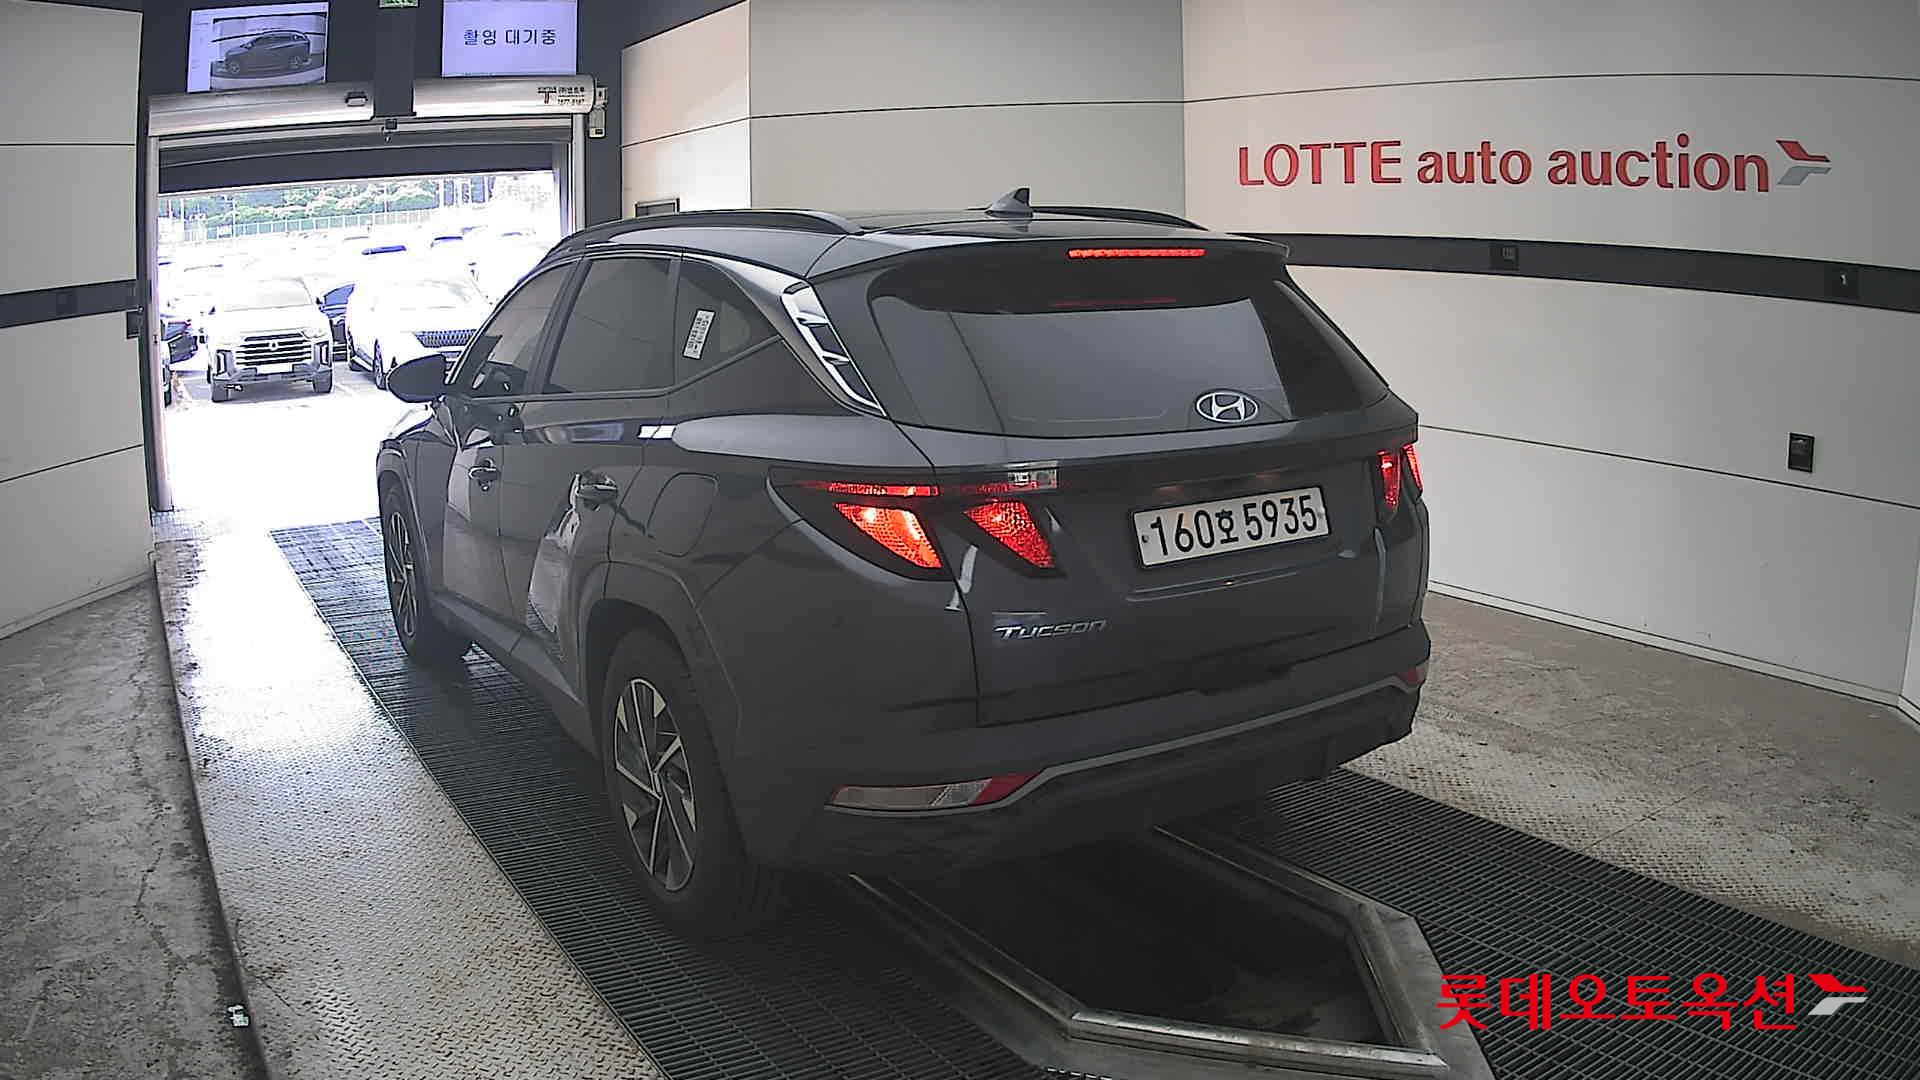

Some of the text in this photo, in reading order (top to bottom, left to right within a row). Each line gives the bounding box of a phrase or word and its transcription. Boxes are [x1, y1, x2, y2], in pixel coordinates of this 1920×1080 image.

[464, 29, 556, 45] 촬영 대기중
[1238, 133, 1769, 192] LOTTE auto auction
[1150, 495, 1317, 556] 160호 5935
